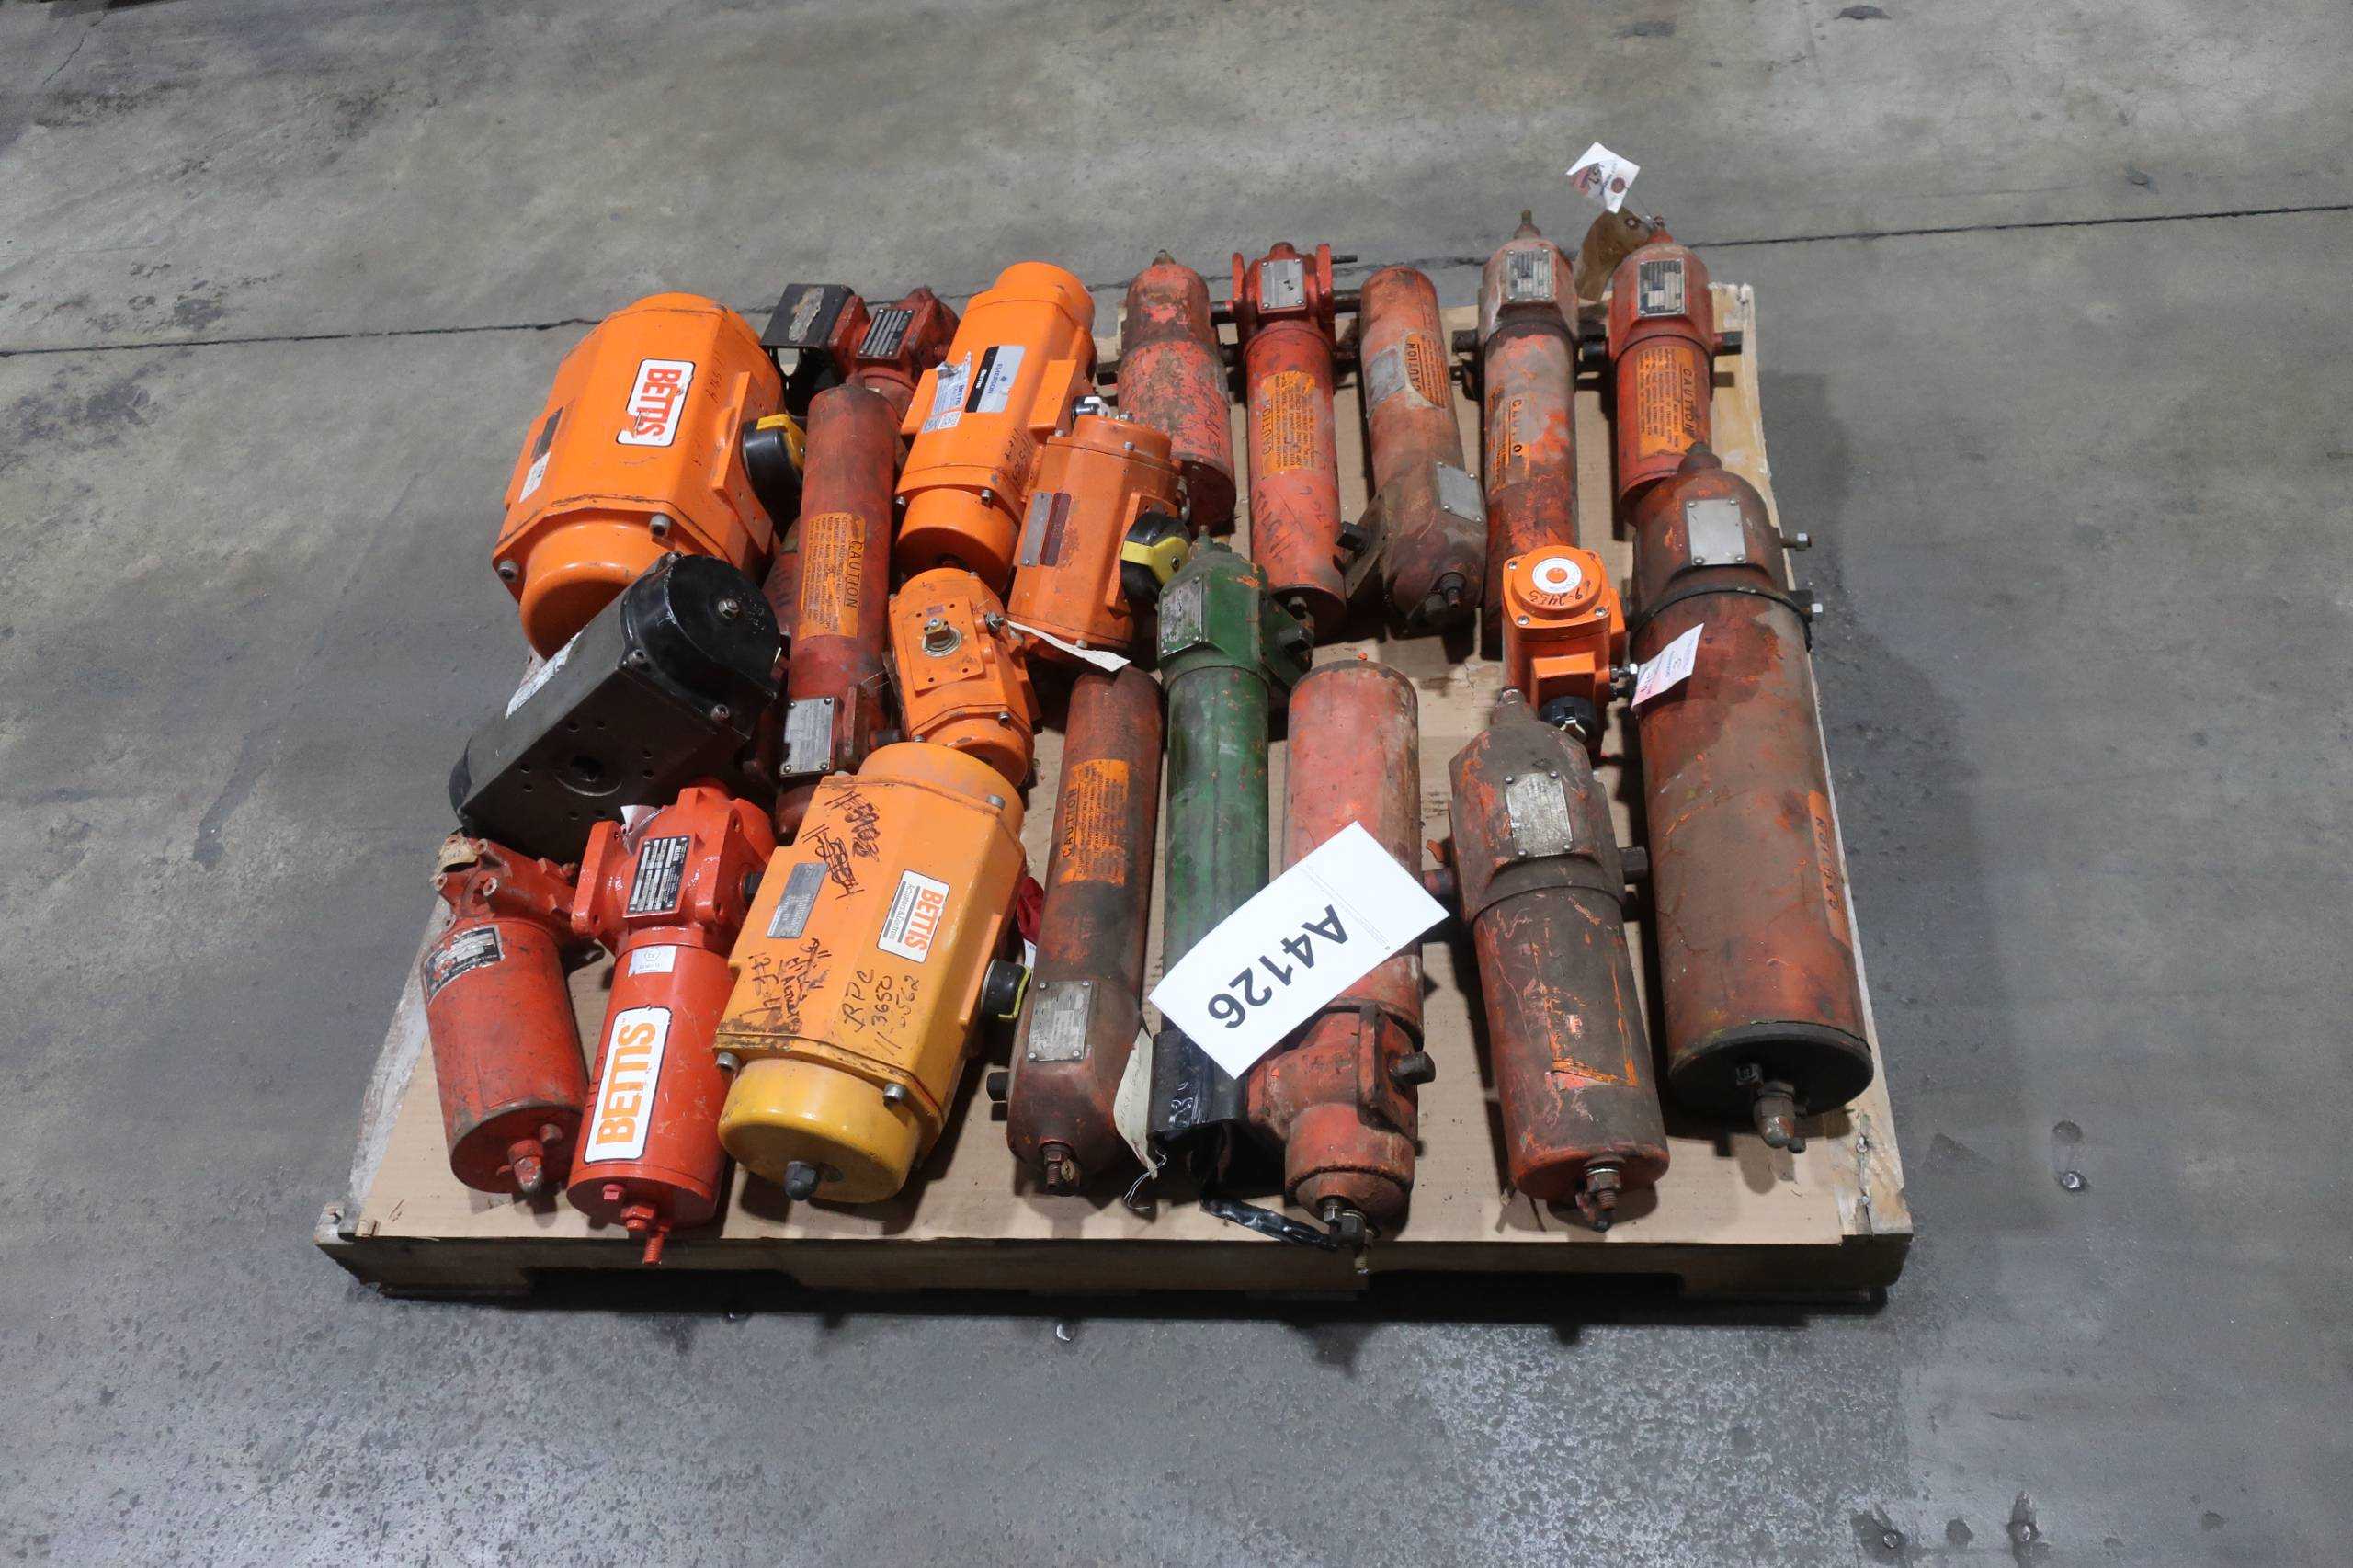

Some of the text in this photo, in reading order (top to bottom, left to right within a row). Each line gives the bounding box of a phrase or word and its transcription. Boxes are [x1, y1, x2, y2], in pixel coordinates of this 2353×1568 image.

[986, 363, 1003, 394] EMERSON
[845, 540, 863, 609] CAUTION
[1062, 788, 1077, 858] CAUTION
[904, 888, 945, 951] BETTIS
[1208, 903, 1348, 1027] A4126
[595, 1023, 656, 1145] BETTIS
